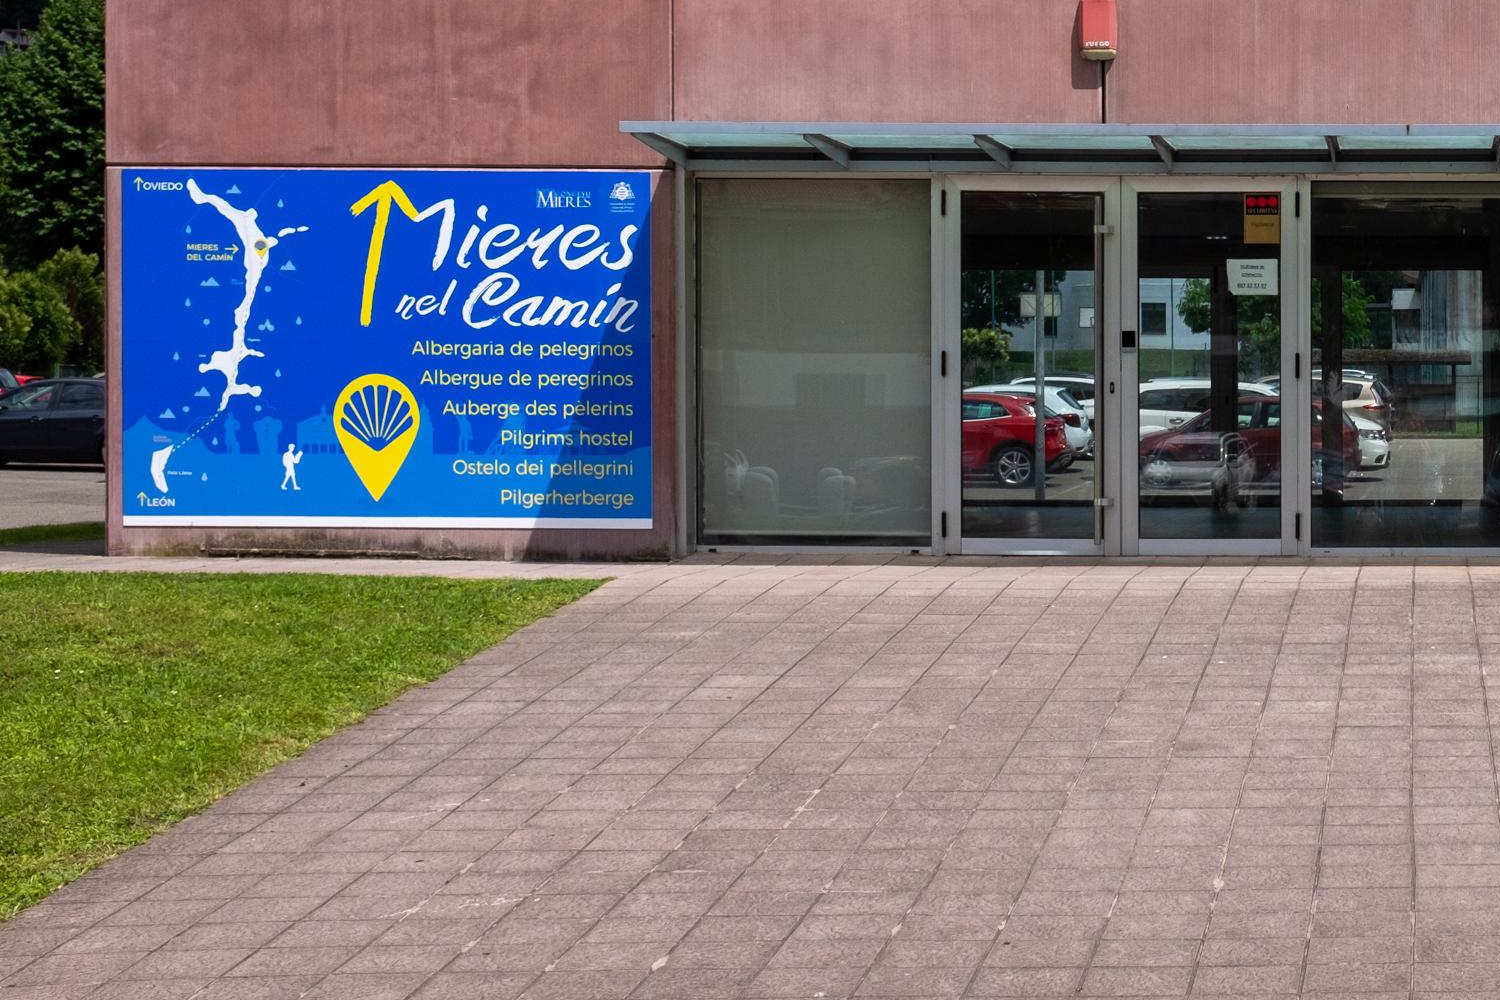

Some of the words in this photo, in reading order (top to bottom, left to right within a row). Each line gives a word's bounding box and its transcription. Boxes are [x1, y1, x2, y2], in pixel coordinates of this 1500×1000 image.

[142, 181, 184, 191] OVIEDO
[413, 198, 639, 272] Mieres
[186, 243, 219, 252] MIERES
[186, 253, 203, 261] DEL
[204, 252, 234, 261] CAMÍN
[395, 279, 458, 321] nel
[462, 272, 639, 333] Camín
[412, 340, 504, 360] Albergaria
[509, 340, 534, 357] de
[539, 341, 634, 360] pelegrinos
[420, 369, 504, 389] Albergue
[508, 369, 532, 386] de
[537, 370, 634, 390] peregrinos
[442, 399, 520, 419] Auberge
[525, 399, 558, 416] des
[562, 399, 634, 419] pèlerins
[500, 429, 574, 449] Pilgrims
[579, 429, 633, 446] hostel
[452, 458, 510, 476] Ostelo
[515, 459, 544, 476] dei
[550, 459, 634, 480] pellegrini
[146, 495, 176, 508] LEÓN
[500, 488, 635, 510] Pilgerherberge
